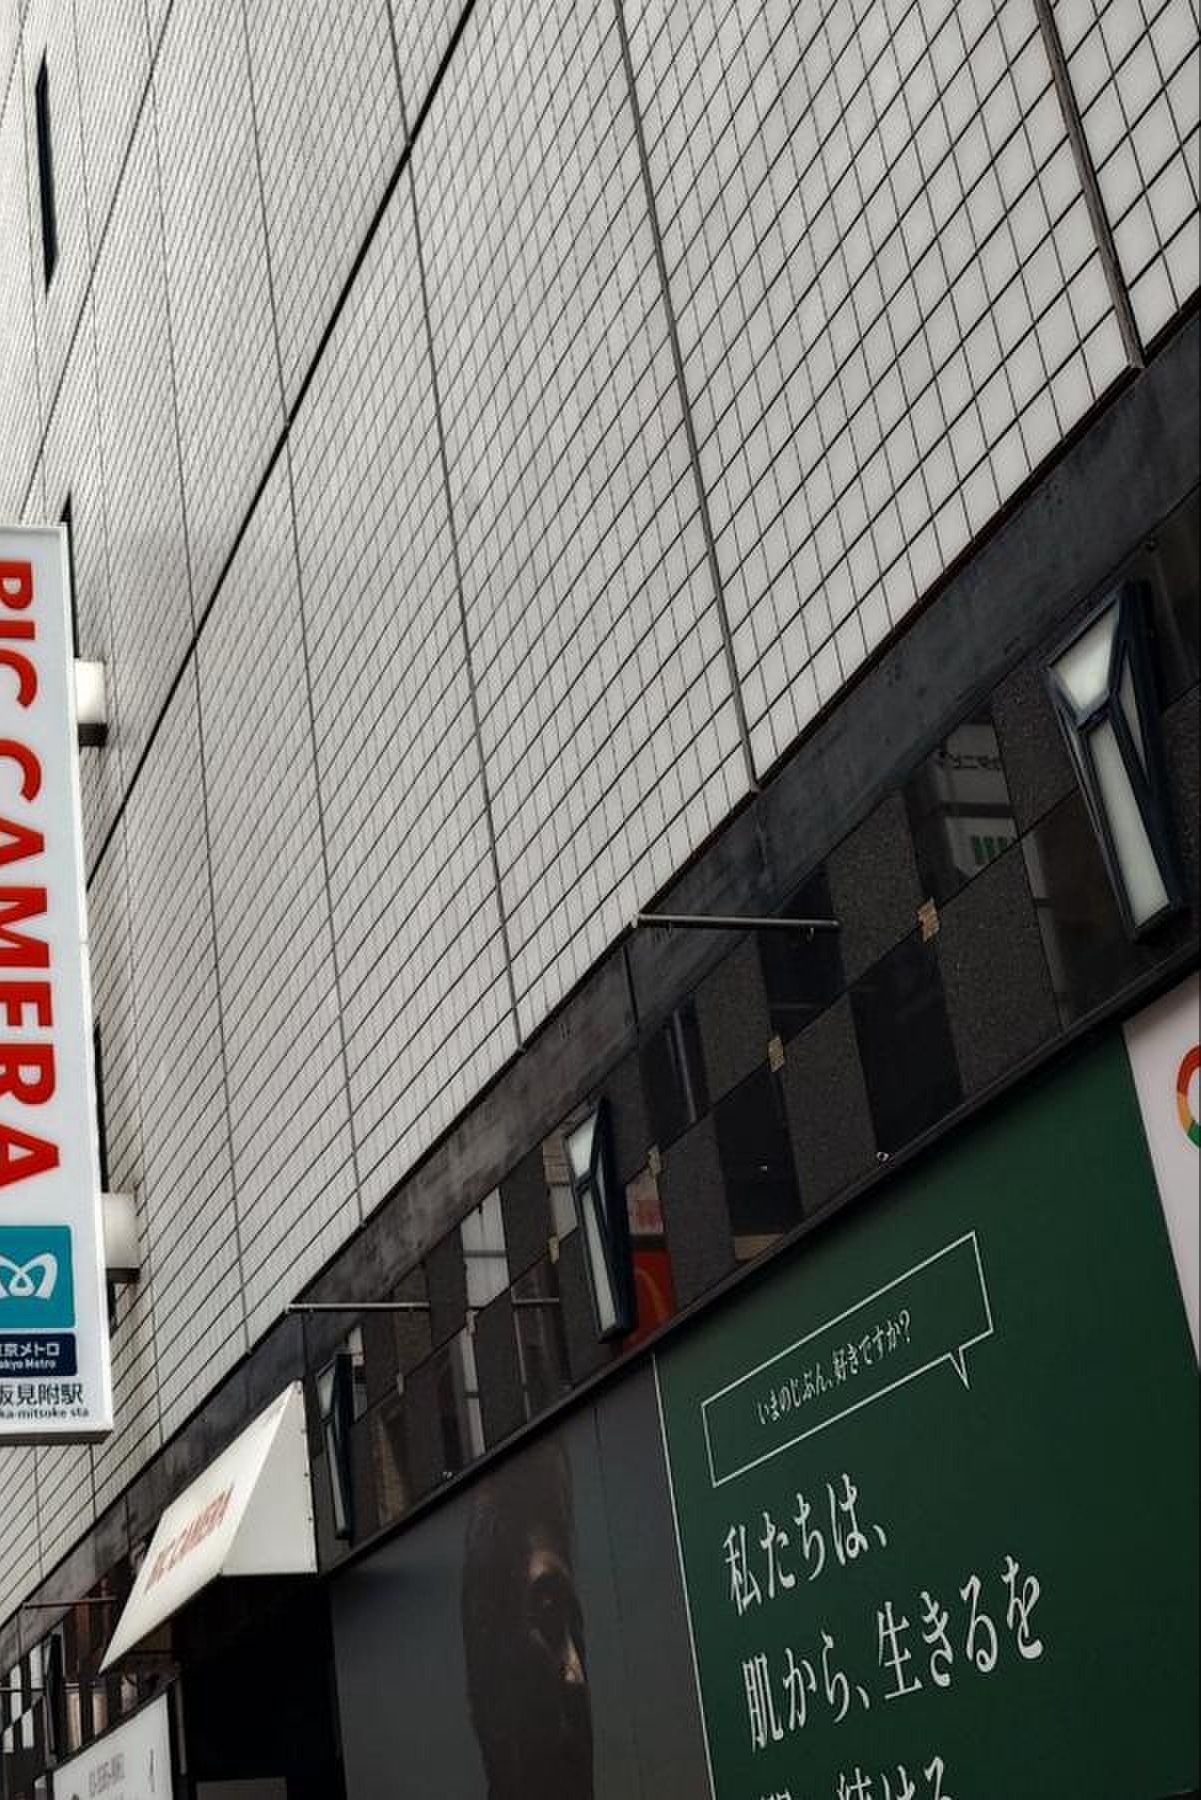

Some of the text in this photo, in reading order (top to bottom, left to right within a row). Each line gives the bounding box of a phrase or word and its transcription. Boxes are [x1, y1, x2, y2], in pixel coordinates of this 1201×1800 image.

[25, 1358, 57, 1369] Metro
[724, 1473, 887, 1616] 私たちは、
